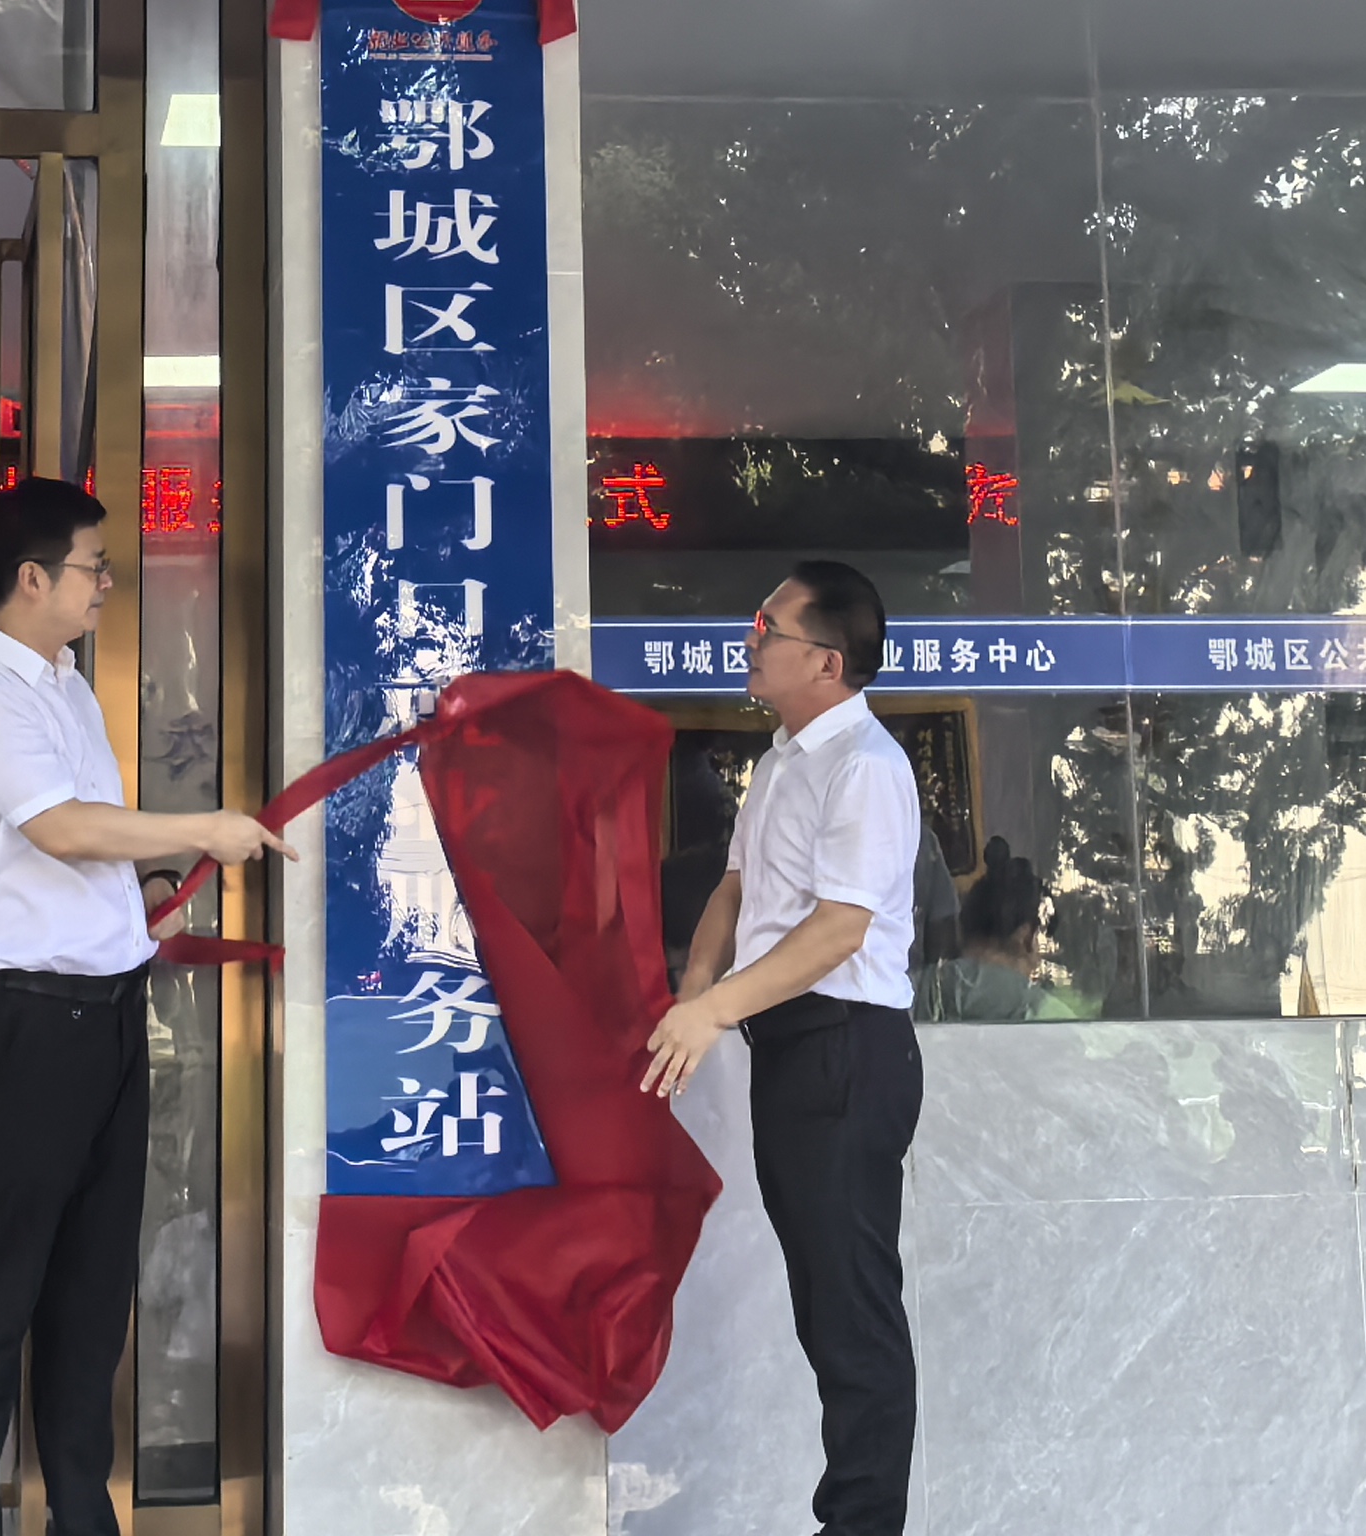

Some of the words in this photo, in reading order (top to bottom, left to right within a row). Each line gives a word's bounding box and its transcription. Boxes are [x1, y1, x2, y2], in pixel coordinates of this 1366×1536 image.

[643, 638, 1057, 676] 鄂城区业服务中心
